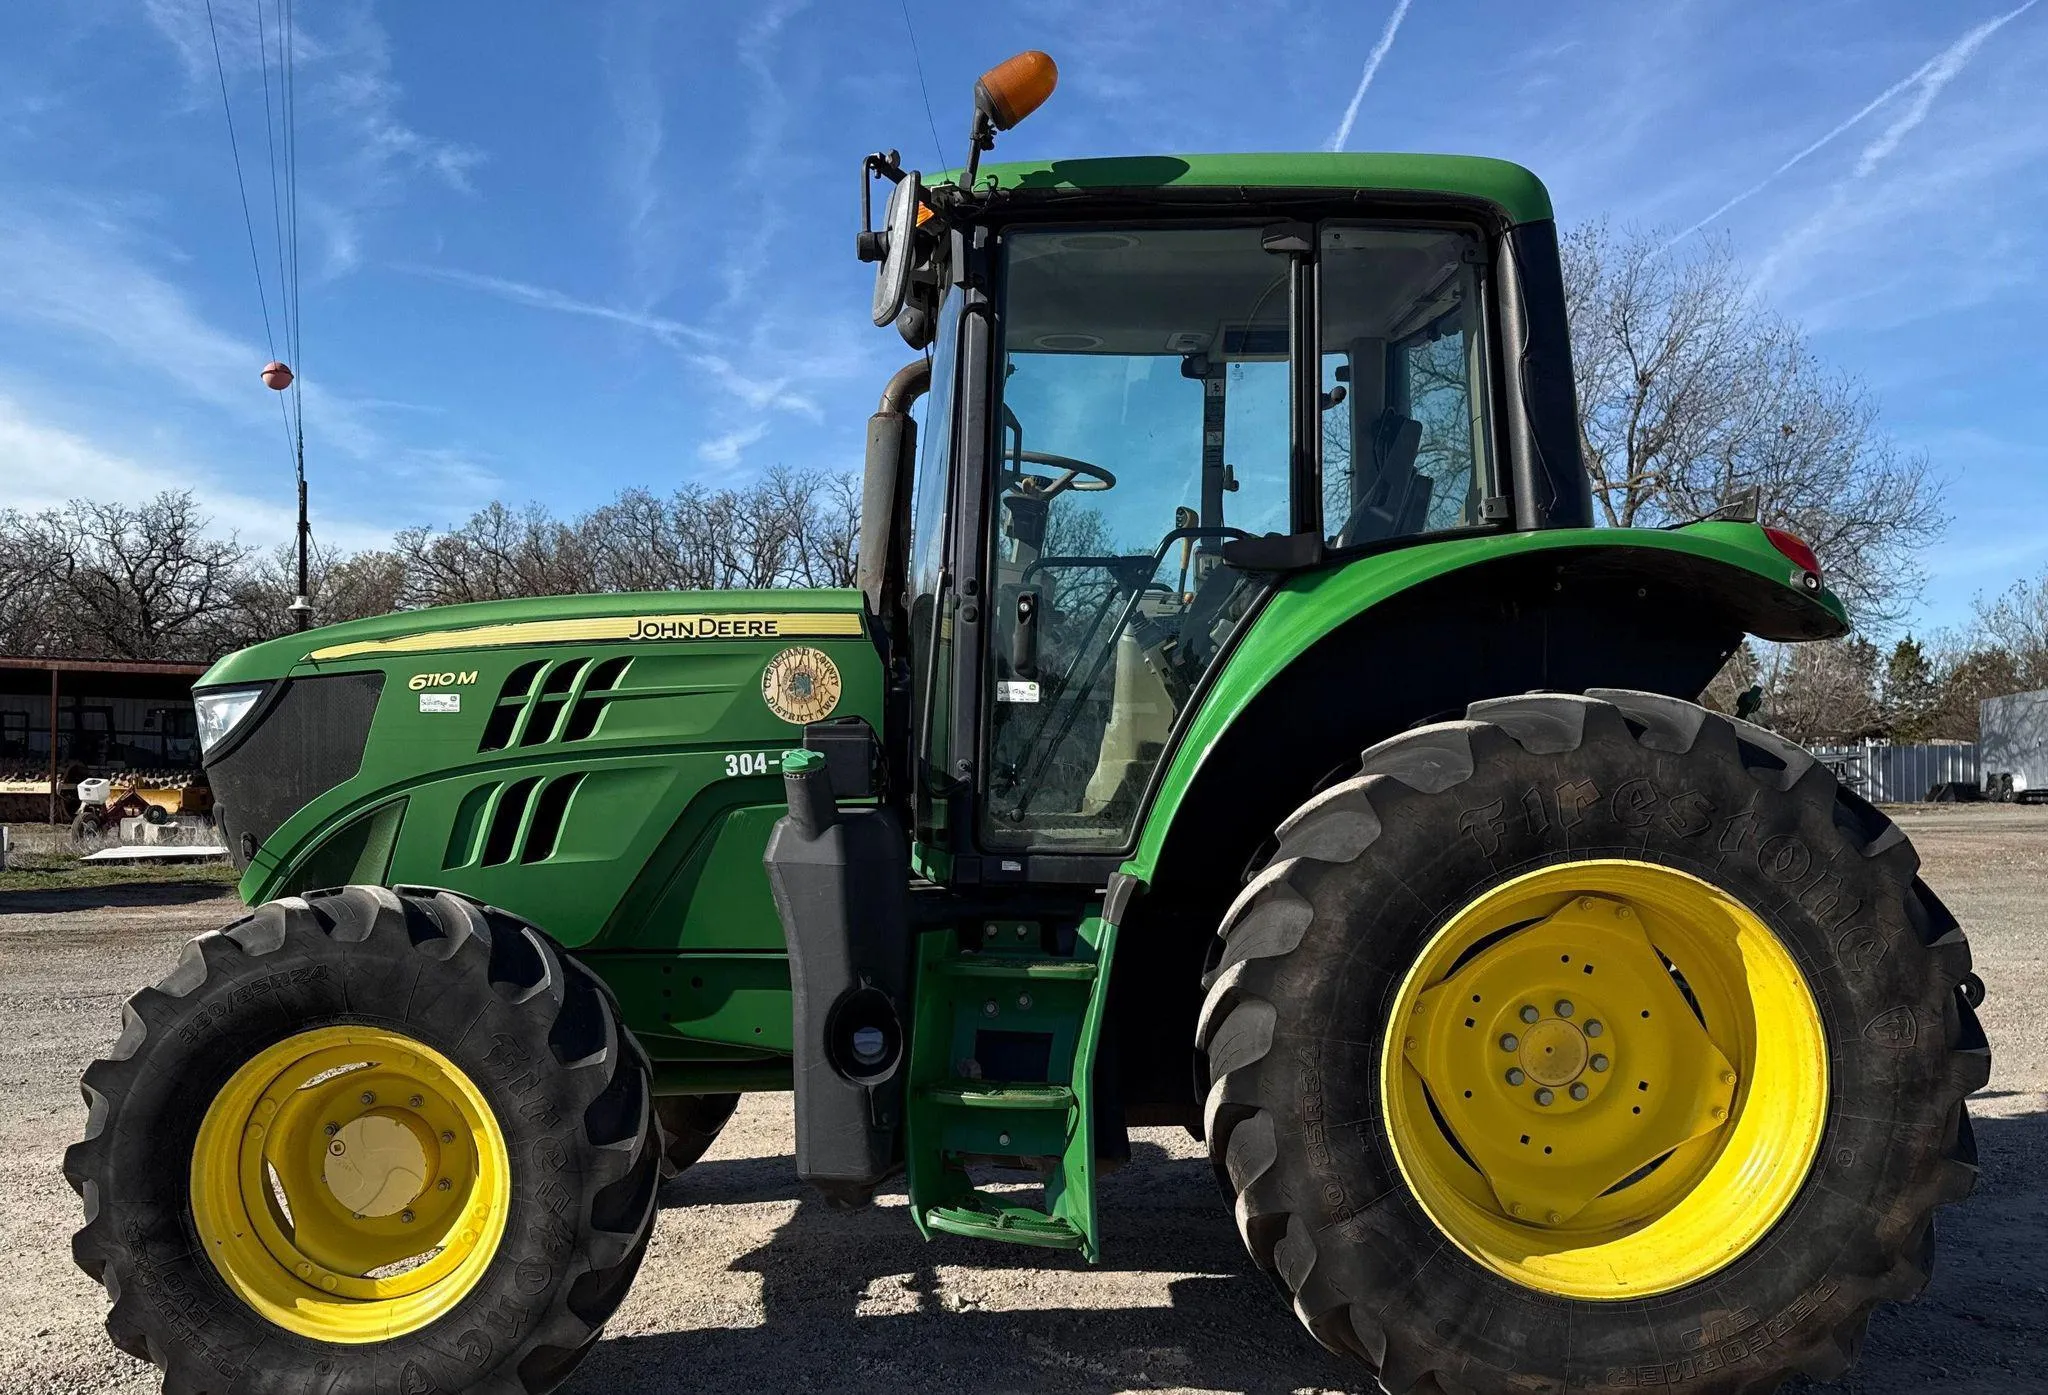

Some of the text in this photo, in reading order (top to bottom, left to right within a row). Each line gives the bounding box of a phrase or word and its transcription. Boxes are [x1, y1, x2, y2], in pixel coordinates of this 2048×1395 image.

[630, 618, 778, 638] JOHN DEERE
[763, 648, 839, 688] CLEVELAND COUNTY
[766, 694, 837, 722] DISTRICT TWO
[1459, 777, 1891, 974] Firestone
[1606, 1276, 1840, 1387] PERFORMER
